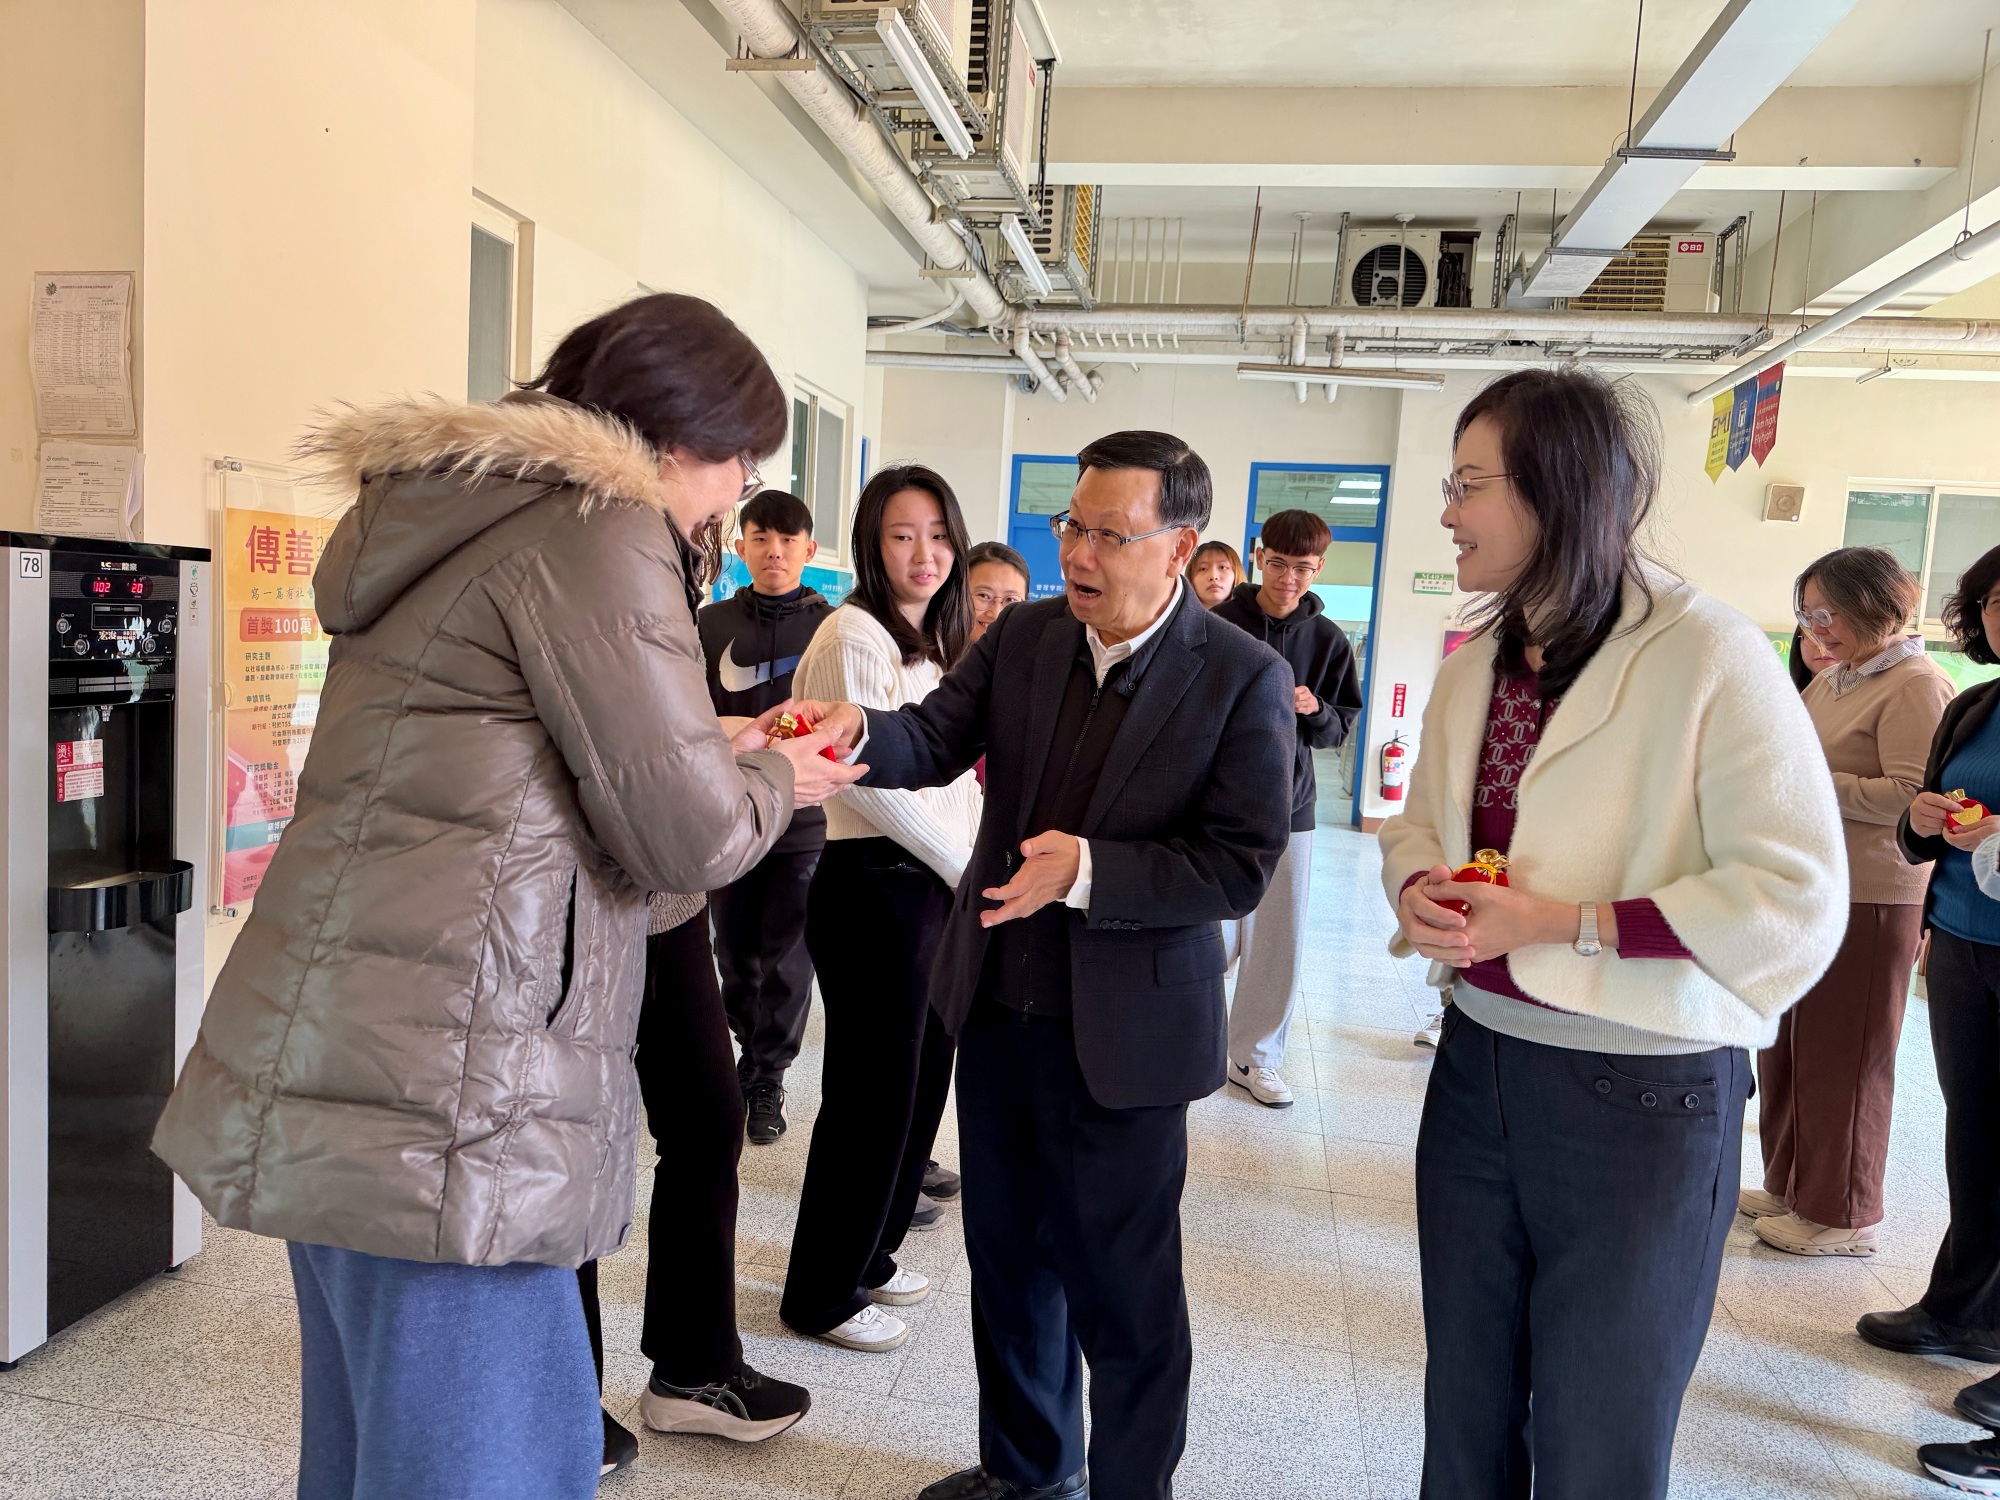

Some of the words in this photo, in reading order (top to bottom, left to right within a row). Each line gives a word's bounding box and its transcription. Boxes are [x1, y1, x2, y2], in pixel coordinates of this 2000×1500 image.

[245, 524, 315, 576] 傳善
[23, 557, 40, 573] 78
[1036, 584, 1065, 592] 管理學院
[247, 616, 313, 635] 首獎100萬
[245, 652, 271, 661] 研究主題
[267, 832, 282, 843] 期刊
